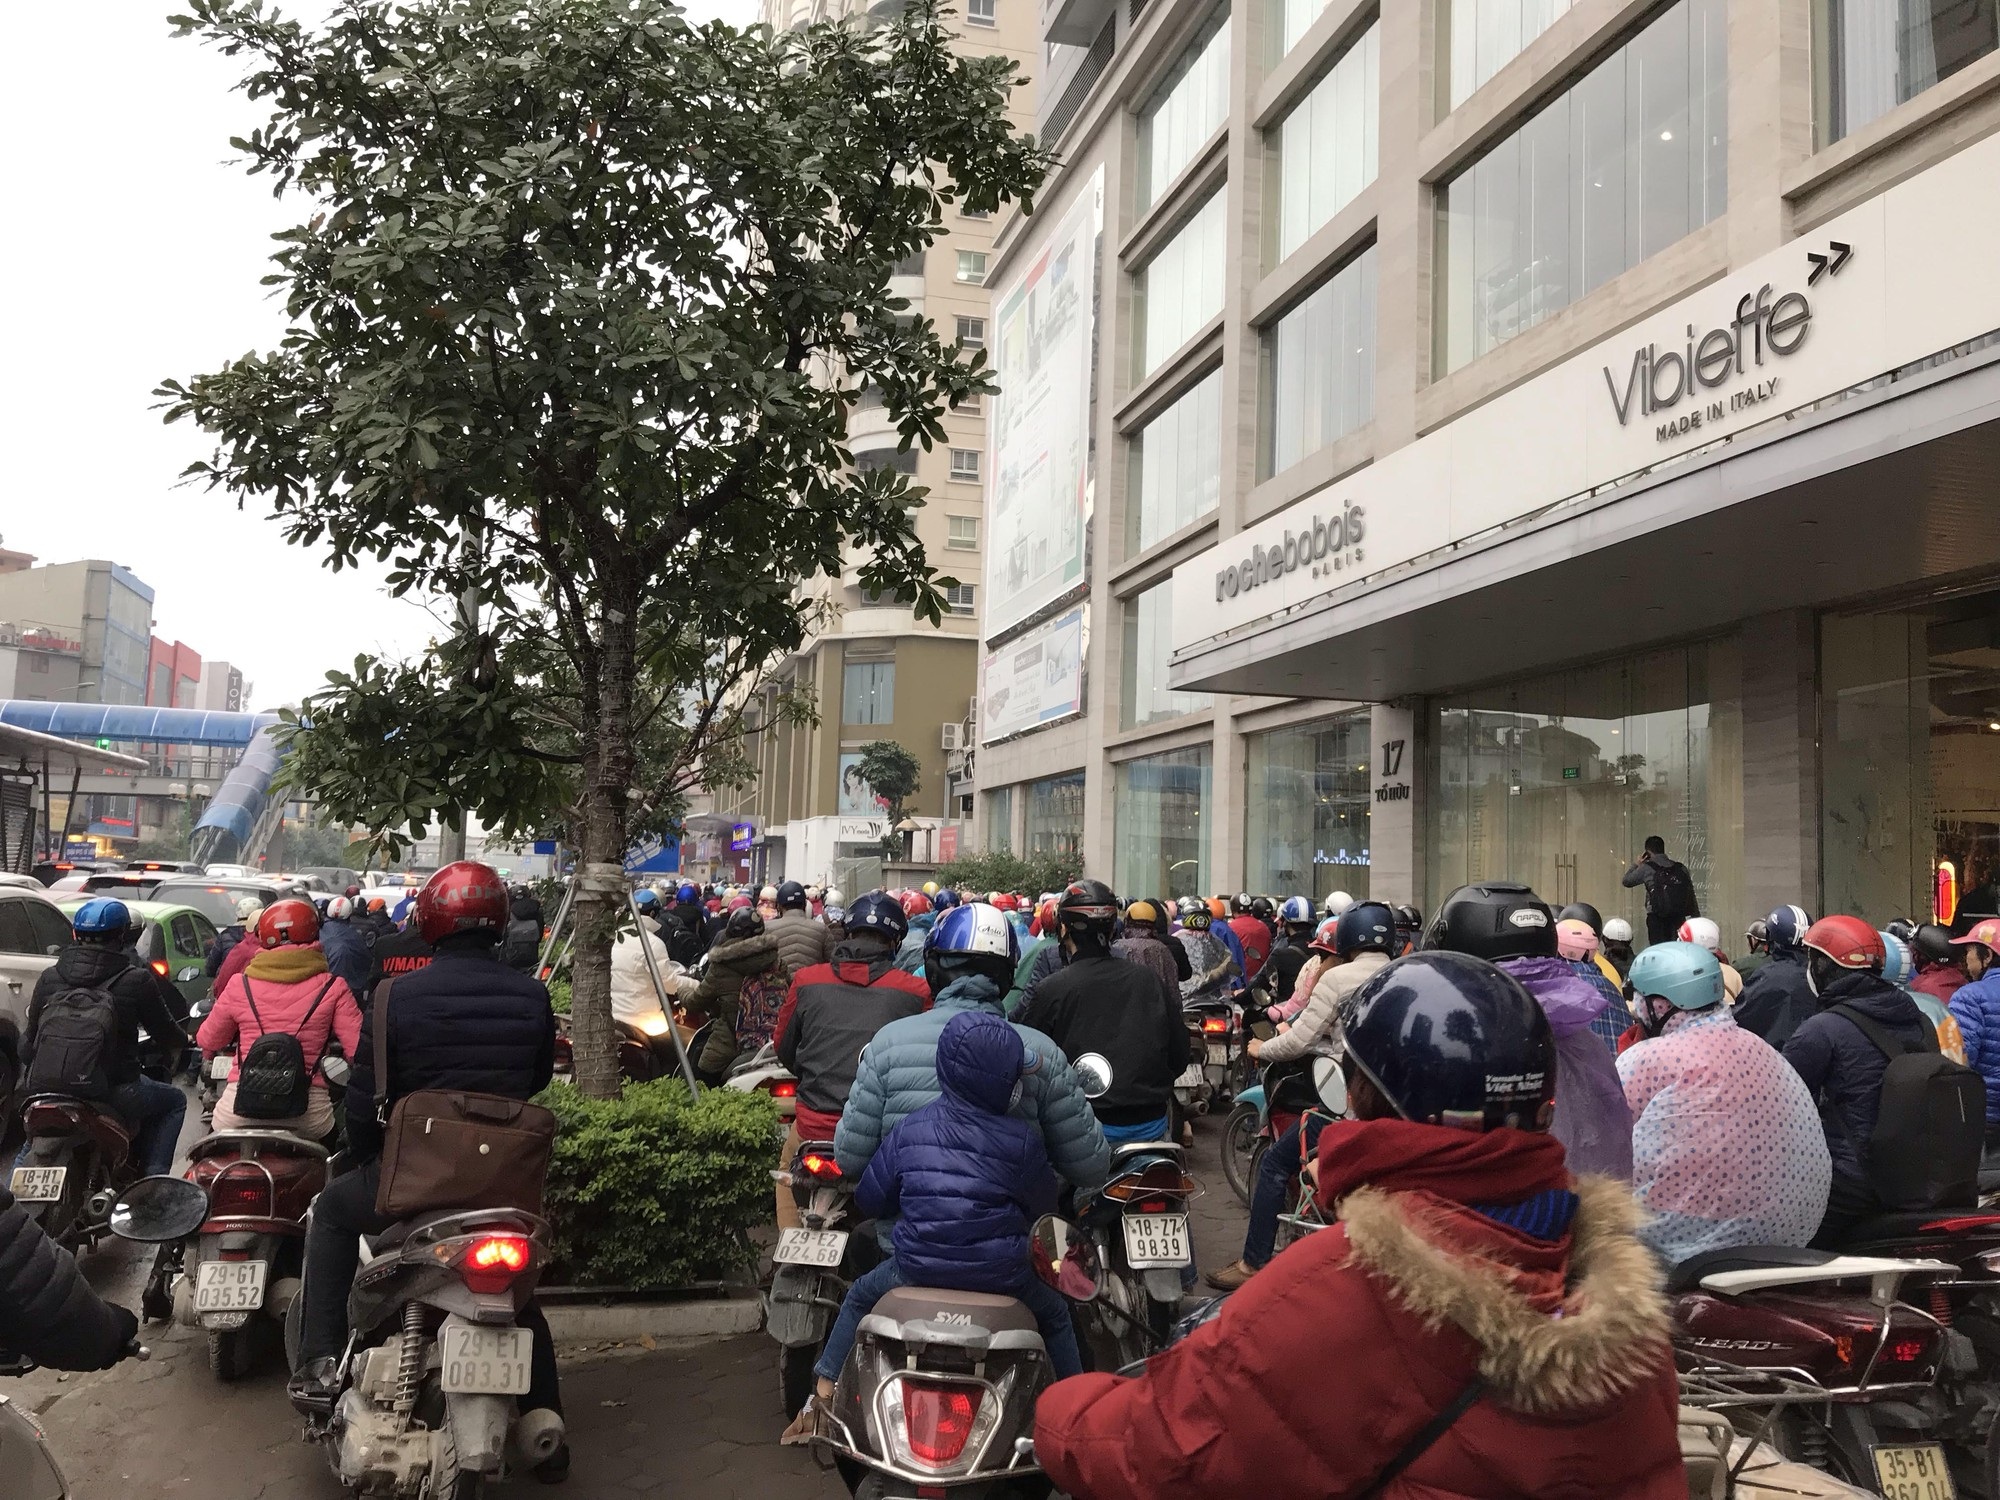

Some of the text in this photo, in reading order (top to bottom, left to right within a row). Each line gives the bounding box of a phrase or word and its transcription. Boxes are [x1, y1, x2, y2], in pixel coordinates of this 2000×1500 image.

[1603, 283, 1812, 425] Vibieffe
[1656, 377, 1779, 441] MADE IN ITALY
[1216, 499, 1364, 602] rochebobois
[1312, 548, 1363, 580] PARIS
[1382, 740, 1405, 776] 17
[1375, 783, 1410, 802] TỐ HỮU
[841, 825, 858, 834] IVY
[1670, 831, 1706, 852] Happy
[1485, 1074, 1524, 1083] Yamaha
[23, 1170, 57, 1184] 18-H1
[1136, 1218, 1177, 1236] 18-Z7
[789, 1230, 838, 1247] 29-E2
[1138, 1238, 1180, 1257] 98.39
[779, 1245, 838, 1263] 024.68
[207, 1265, 256, 1285] 29-G1
[199, 1287, 260, 1307] 035.52
[934, 1311, 971, 1326] SYM
[458, 1331, 519, 1358] 29-E1
[450, 1361, 524, 1389] 083.31
[1884, 1449, 1937, 1479] 35-B1
